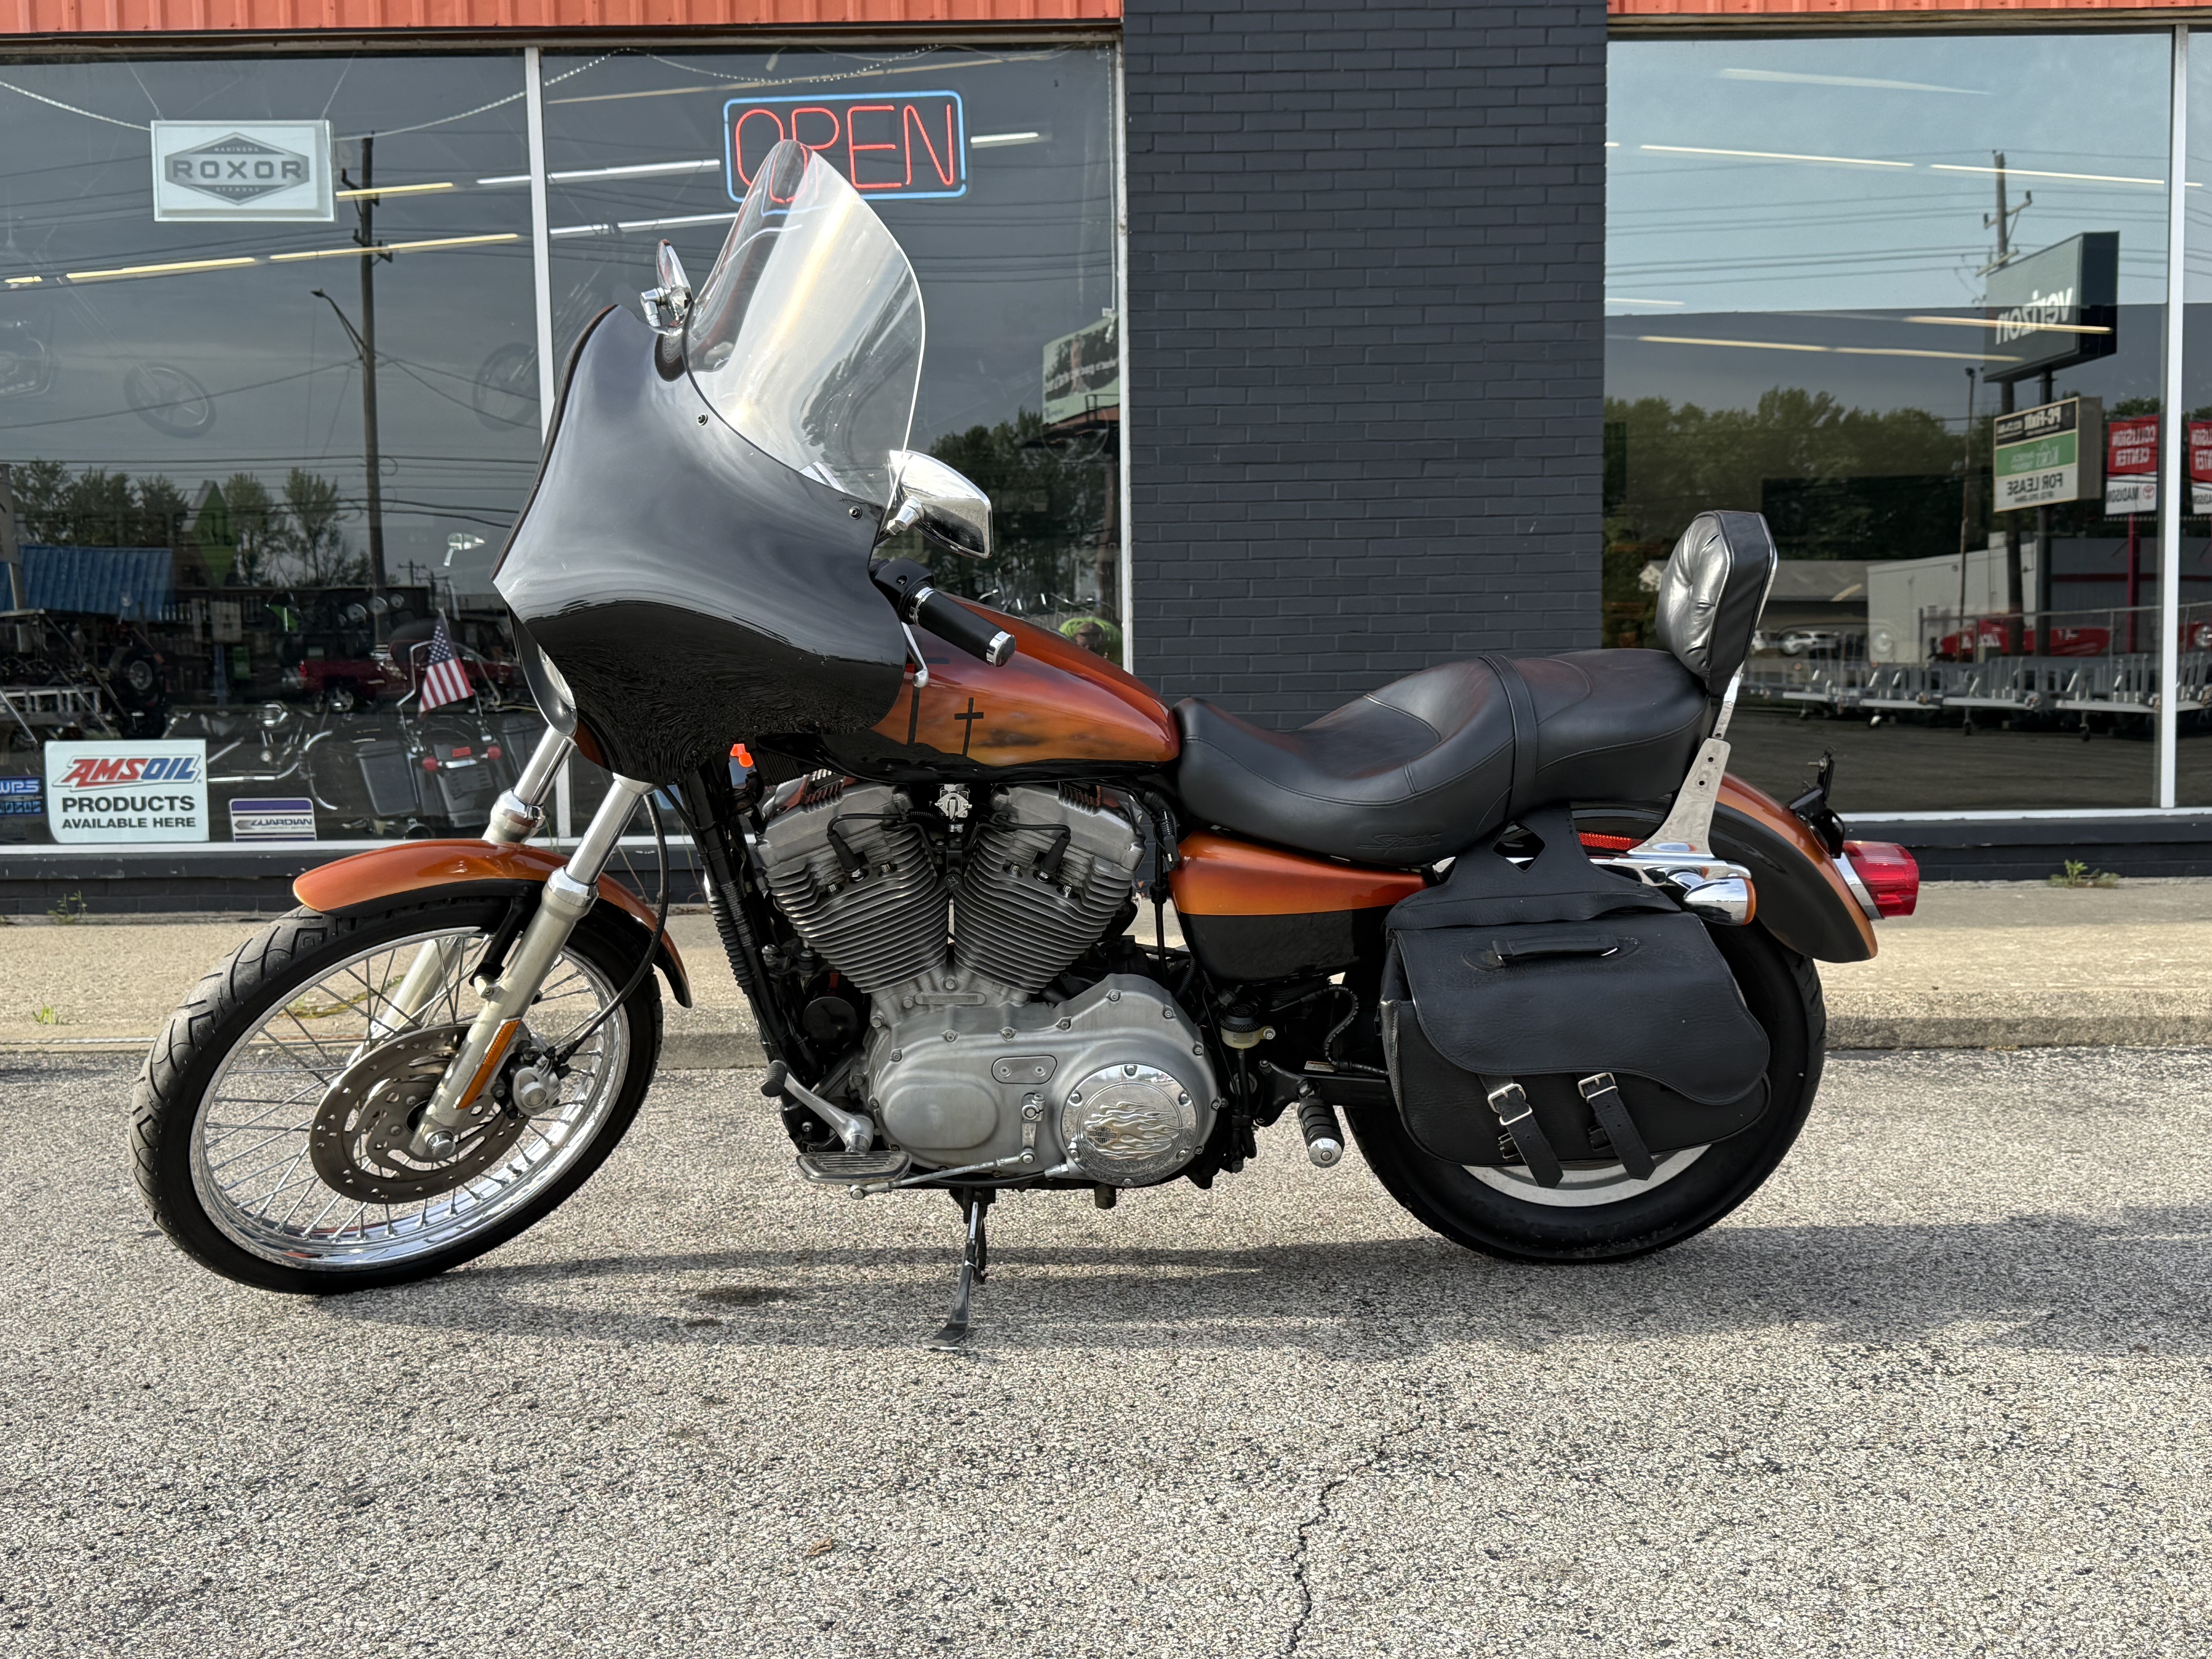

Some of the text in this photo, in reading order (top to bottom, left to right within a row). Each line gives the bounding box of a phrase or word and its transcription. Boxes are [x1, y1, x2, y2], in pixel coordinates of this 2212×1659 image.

[735, 104, 955, 196] OPEN
[172, 160, 302, 179] ROXOR
[62, 758, 198, 787] AMSOIL
[0, 780, 39, 794] WPS
[62, 795, 195, 812] PRODUCTS
[62, 817, 197, 829] AVAILABLE HERE
